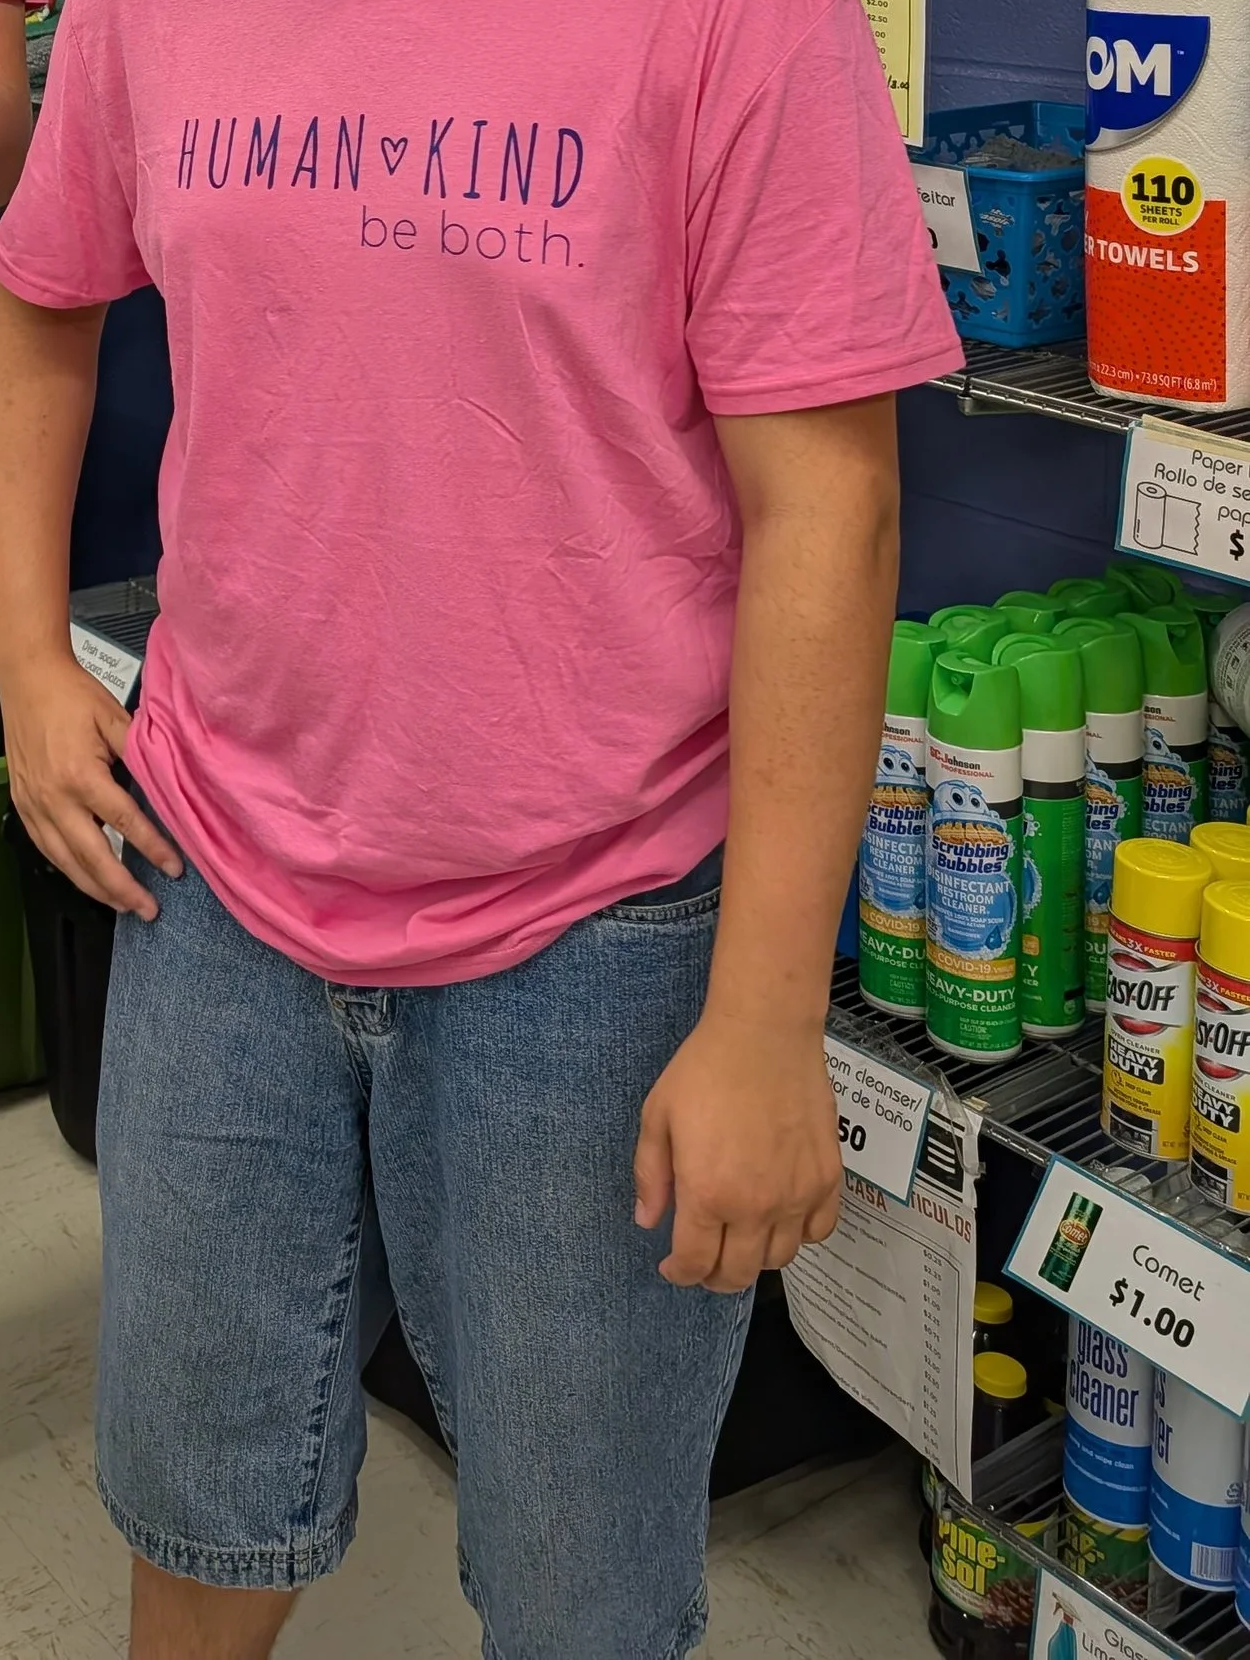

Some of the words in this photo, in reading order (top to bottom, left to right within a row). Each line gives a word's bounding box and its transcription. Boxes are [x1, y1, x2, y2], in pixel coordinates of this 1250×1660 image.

[178, 113, 365, 191] HUMAN
[423, 116, 584, 209] KIND
[1131, 172, 1195, 206] 110
[1140, 203, 1183, 217] SHEETS
[1142, 214, 1158, 224] PER
[1159, 216, 1180, 226] ROLL
[361, 205, 417, 250] be
[440, 209, 585, 268] both.
[1096, 239, 1199, 273] TOWELS
[1100, 363, 1116, 377] 22.3
[1117, 369, 1134, 382] cm)
[1141, 371, 1158, 386] 73.9
[1159, 374, 1170, 388] SQ
[1171, 376, 1183, 388] FT
[1183, 377, 1200, 391] (6.8
[1191, 449, 1243, 475] Paper
[1154, 462, 1198, 488] Rollo
[1203, 476, 1226, 494] de
[1229, 529, 1245, 561] $
[81, 639, 98, 656] Dish
[884, 722, 910, 736] hnson
[932, 835, 1009, 861] Scrubbing
[937, 853, 1002, 874] Bubbles
[926, 865, 1011, 894] DISINFECTANT
[937, 884, 994, 905] RESTROOM
[869, 911, 920, 933] COVID-19
[1127, 938, 1143, 953] 3X
[1144, 946, 1177, 959] FASTER
[937, 953, 992, 973] COVID-19
[1206, 978, 1220, 994] 3X
[980, 1002, 1016, 1013] CLEANER
[1110, 1040, 1159, 1069] HEAVY
[1126, 1037, 1160, 1055] CLEANER
[1109, 1050, 1159, 1082] DUTY
[855, 1068, 922, 1112] cleanser/
[1204, 1080, 1236, 1102] CLEANER
[851, 1088, 870, 1109] de
[875, 1099, 913, 1132] baño
[1061, 1220, 1089, 1244] Comet
[1133, 1245, 1205, 1302] Comet
[1109, 1278, 1195, 1348] $1.00
[1077, 1320, 1128, 1379] glass
[1070, 1359, 1139, 1428] cleaner
[1115, 1461, 1135, 1470] clean
[942, 1543, 986, 1596] Sol
